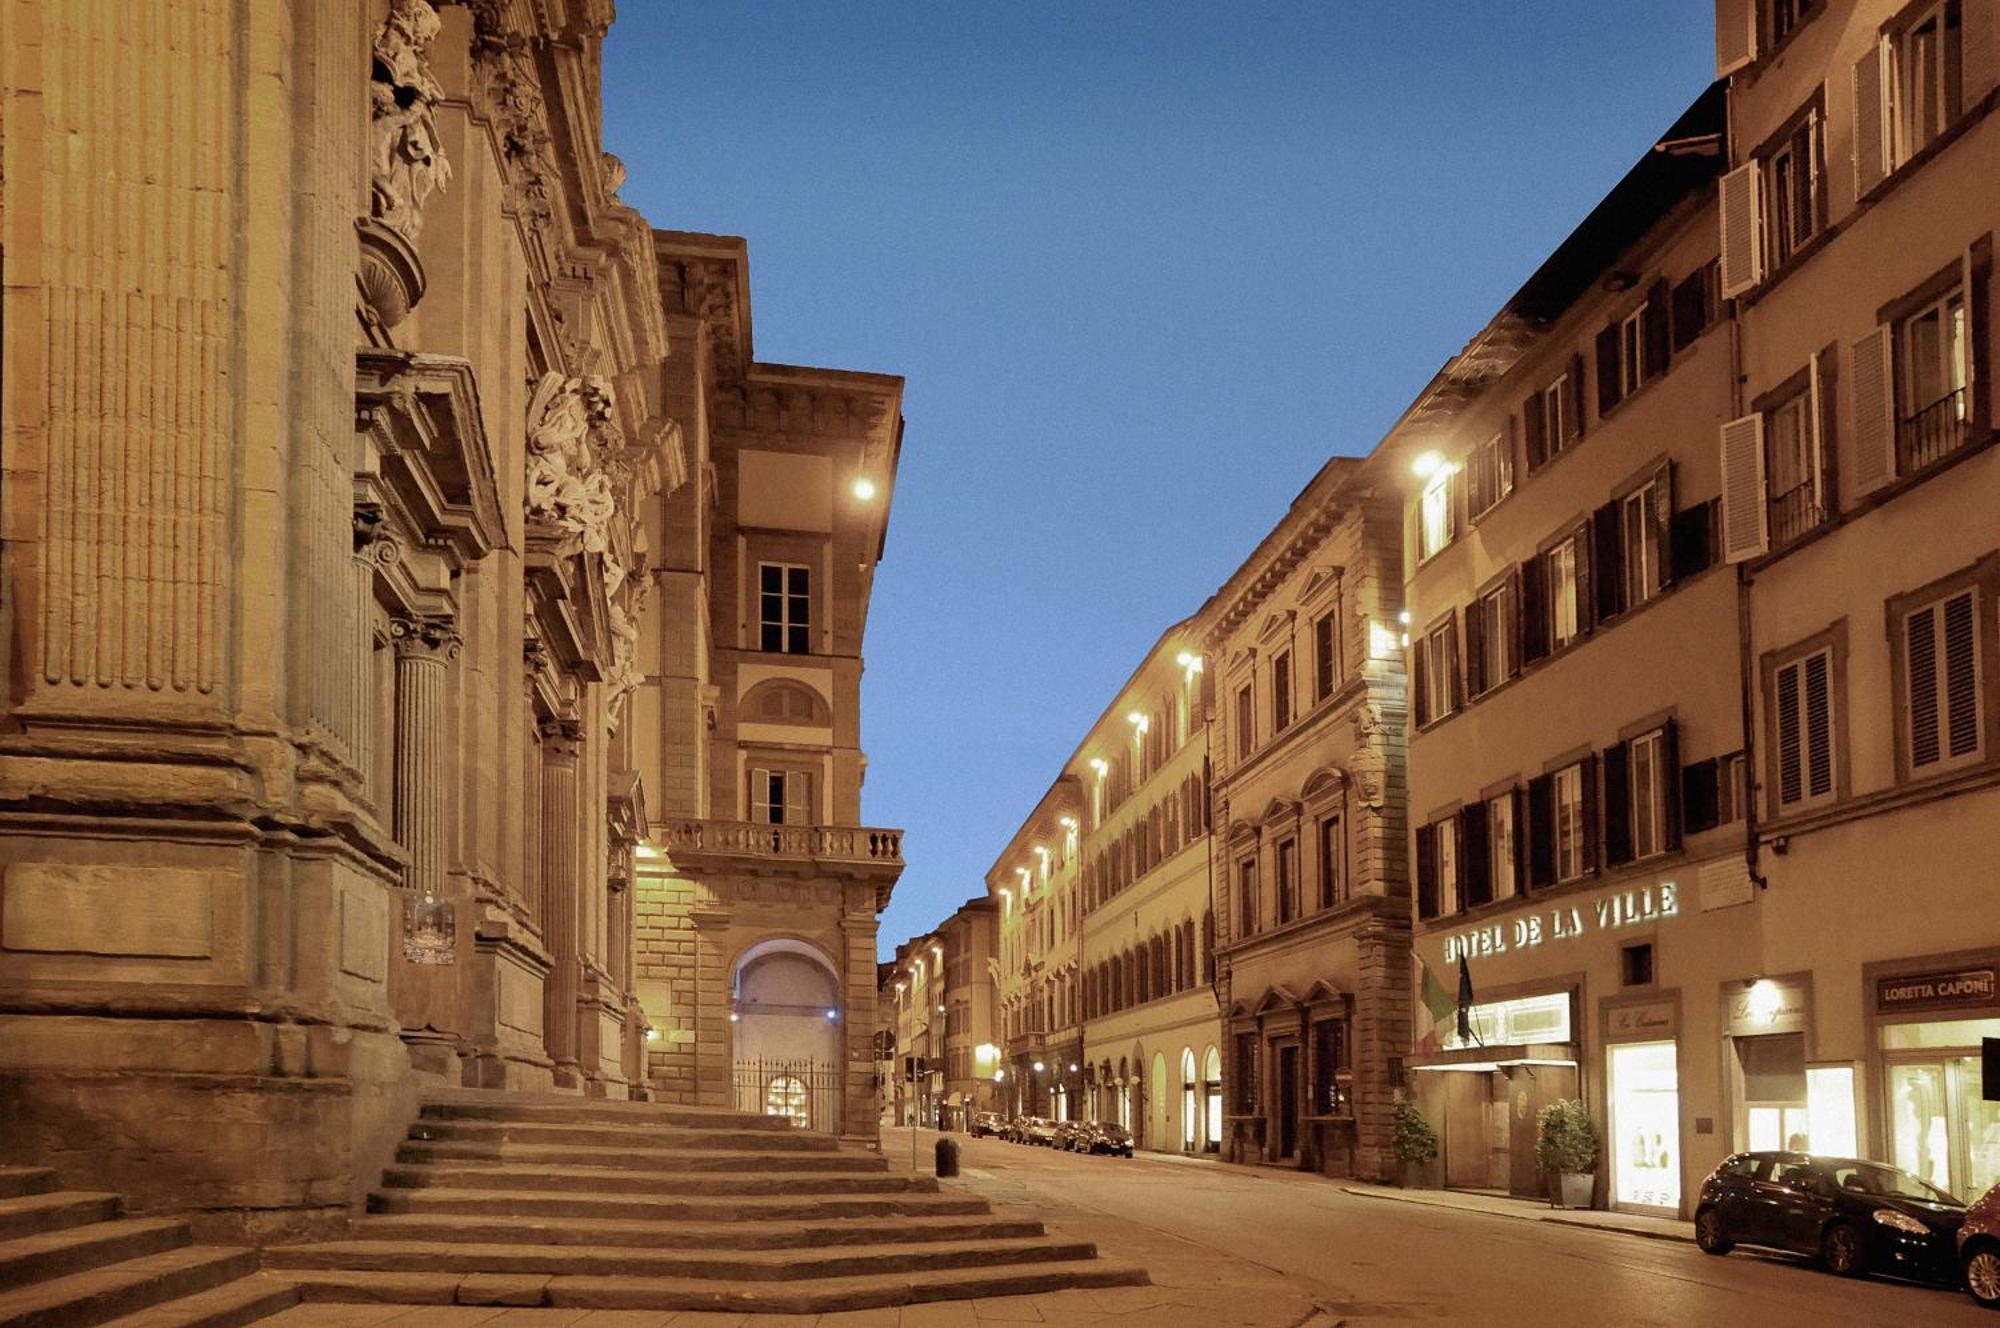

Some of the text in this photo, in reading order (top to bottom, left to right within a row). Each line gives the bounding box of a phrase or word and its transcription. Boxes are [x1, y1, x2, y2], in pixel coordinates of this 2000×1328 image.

[1445, 882, 1679, 964] HOTEL DE LA VILLE
[1884, 979, 1990, 1001] LORETTA CAPONI
